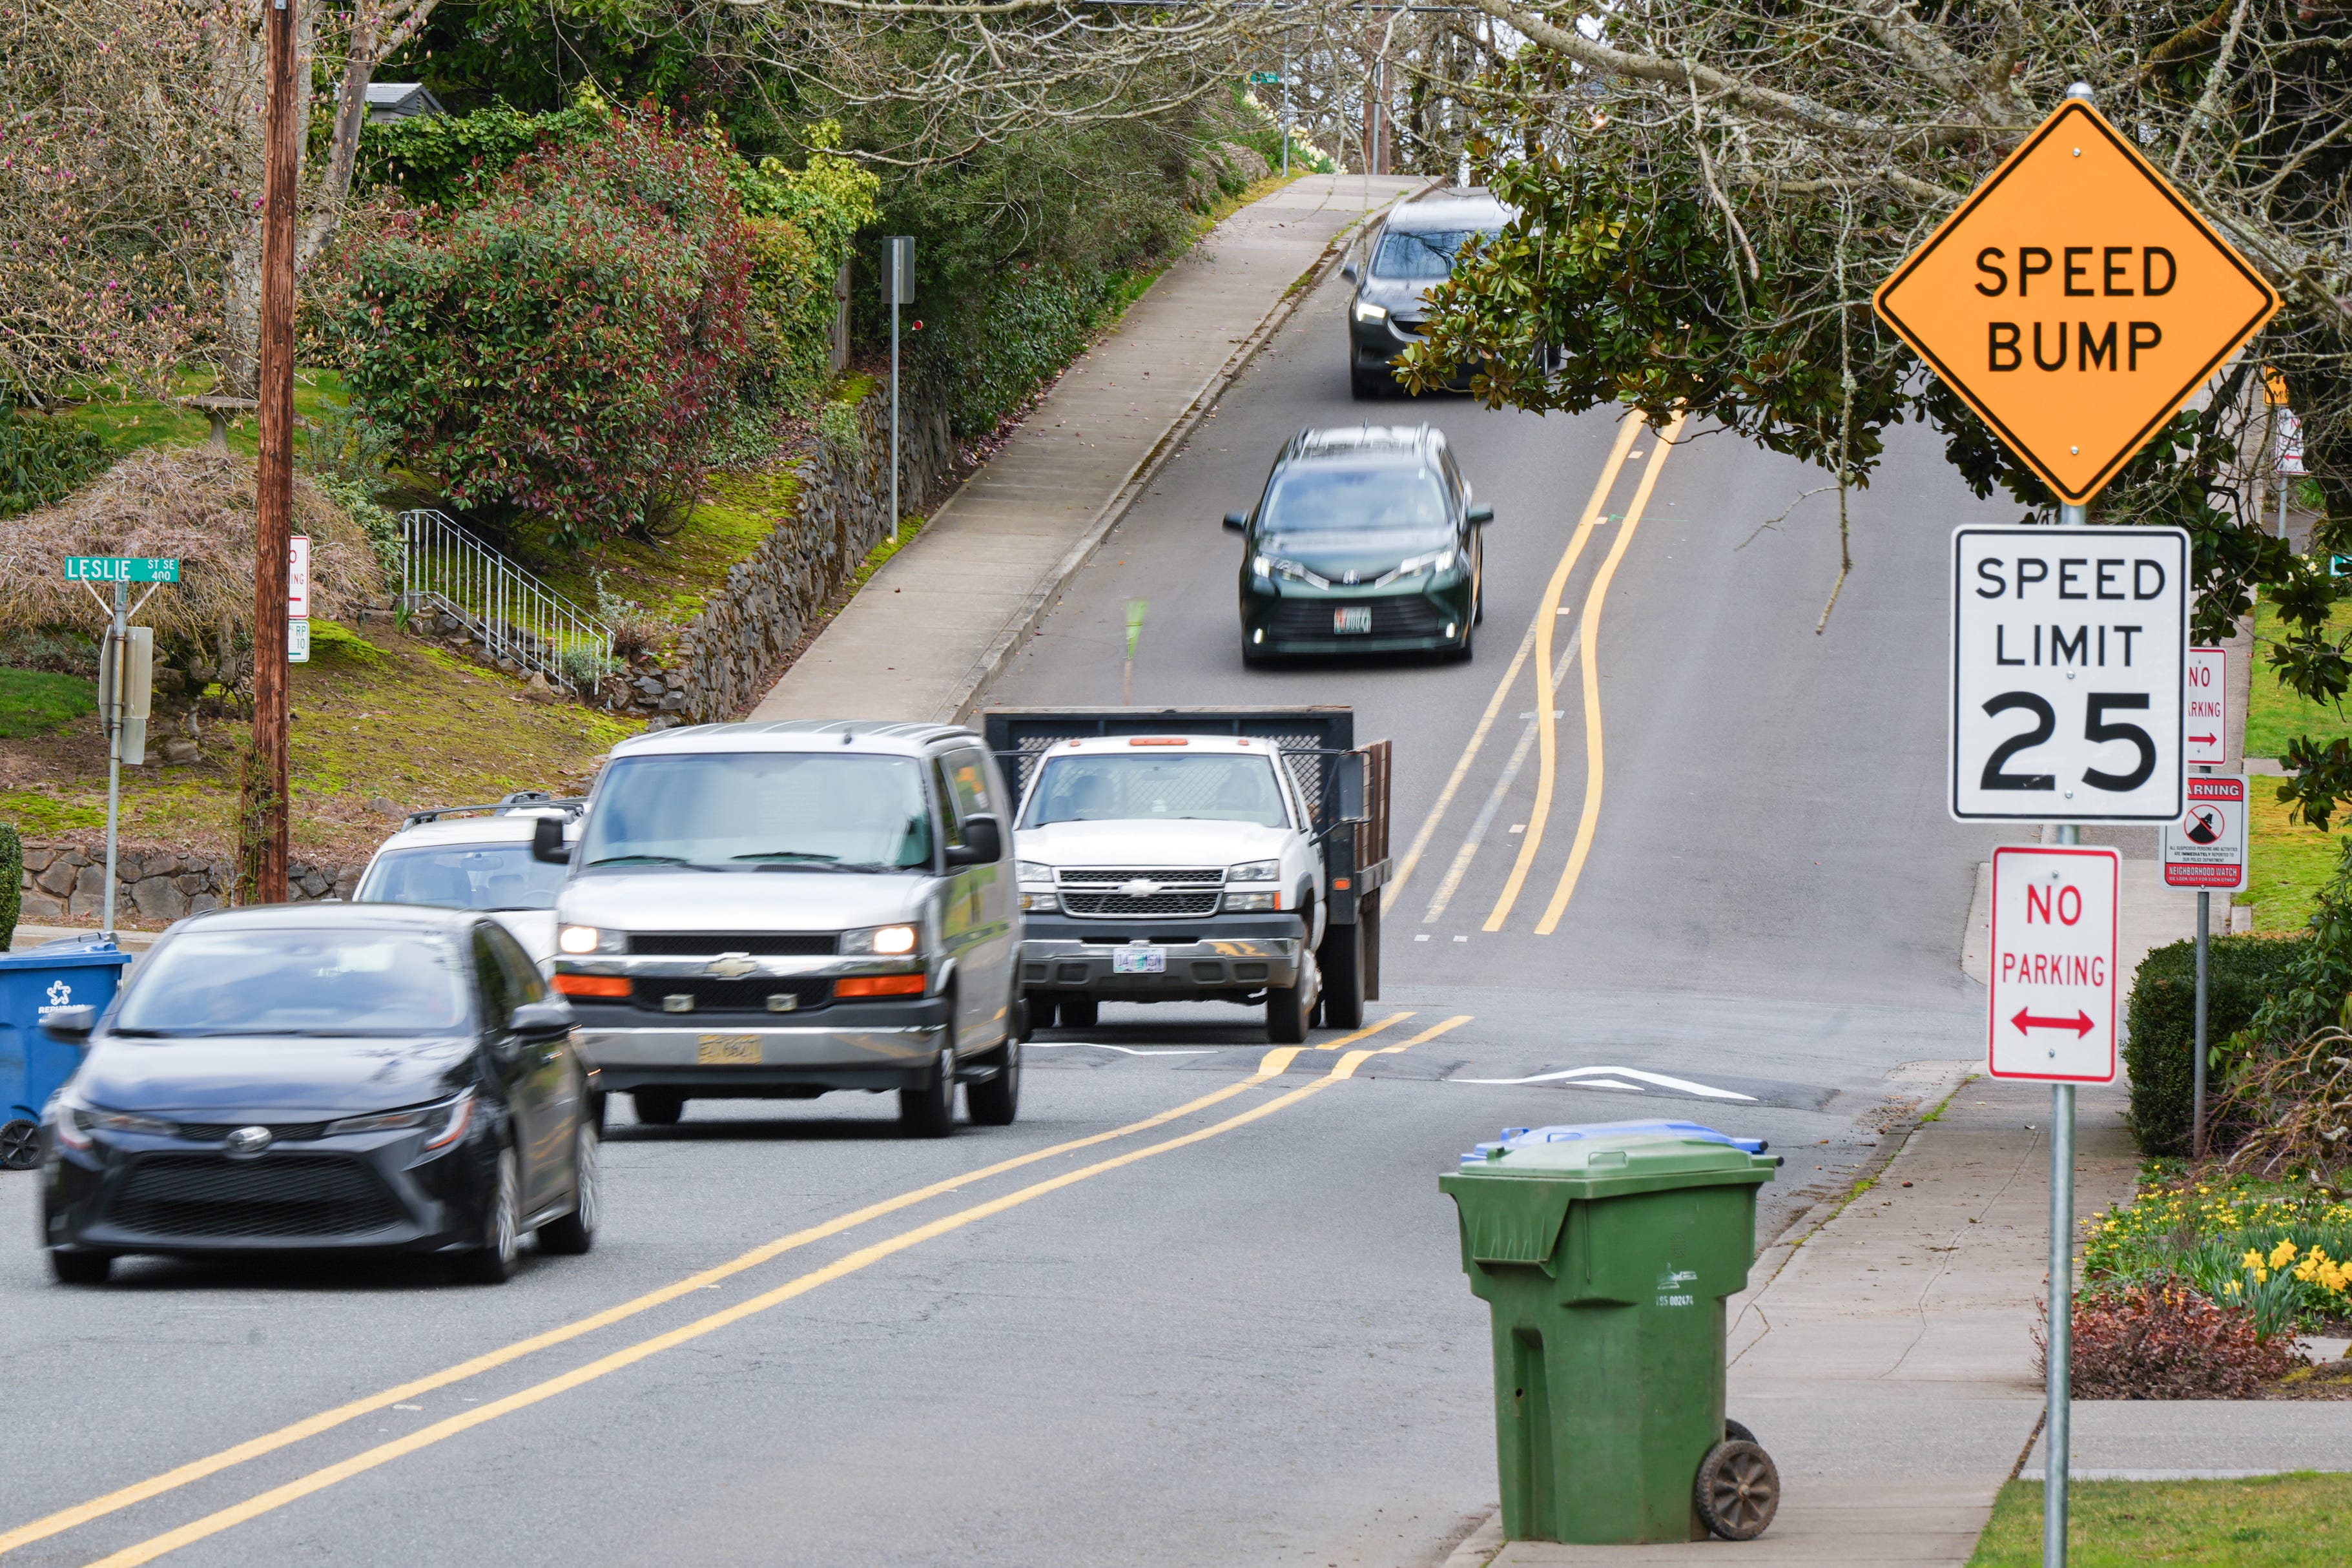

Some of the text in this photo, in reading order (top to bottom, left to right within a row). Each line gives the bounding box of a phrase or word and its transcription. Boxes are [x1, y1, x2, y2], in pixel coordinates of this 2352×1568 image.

[1974, 247, 2177, 297] SPEED
[1988, 321, 2162, 372] BUMP
[68, 559, 175, 579] LESLIE ST SE
[152, 571, 170, 581] 400
[1975, 557, 2165, 600] SPEED
[296, 626, 306, 636] RP
[297, 638, 305, 649] 10
[1997, 624, 2142, 666] LIMIT
[2189, 666, 2210, 687] NO
[2188, 701, 2221, 717] RKING
[1980, 691, 2156, 792] 25
[2187, 784, 2239, 796] ARNING
[2169, 866, 2237, 877] NEIGHBORHOOD WATCH
[2027, 884, 2082, 925] NO
[2003, 953, 2104, 987] PARKING
